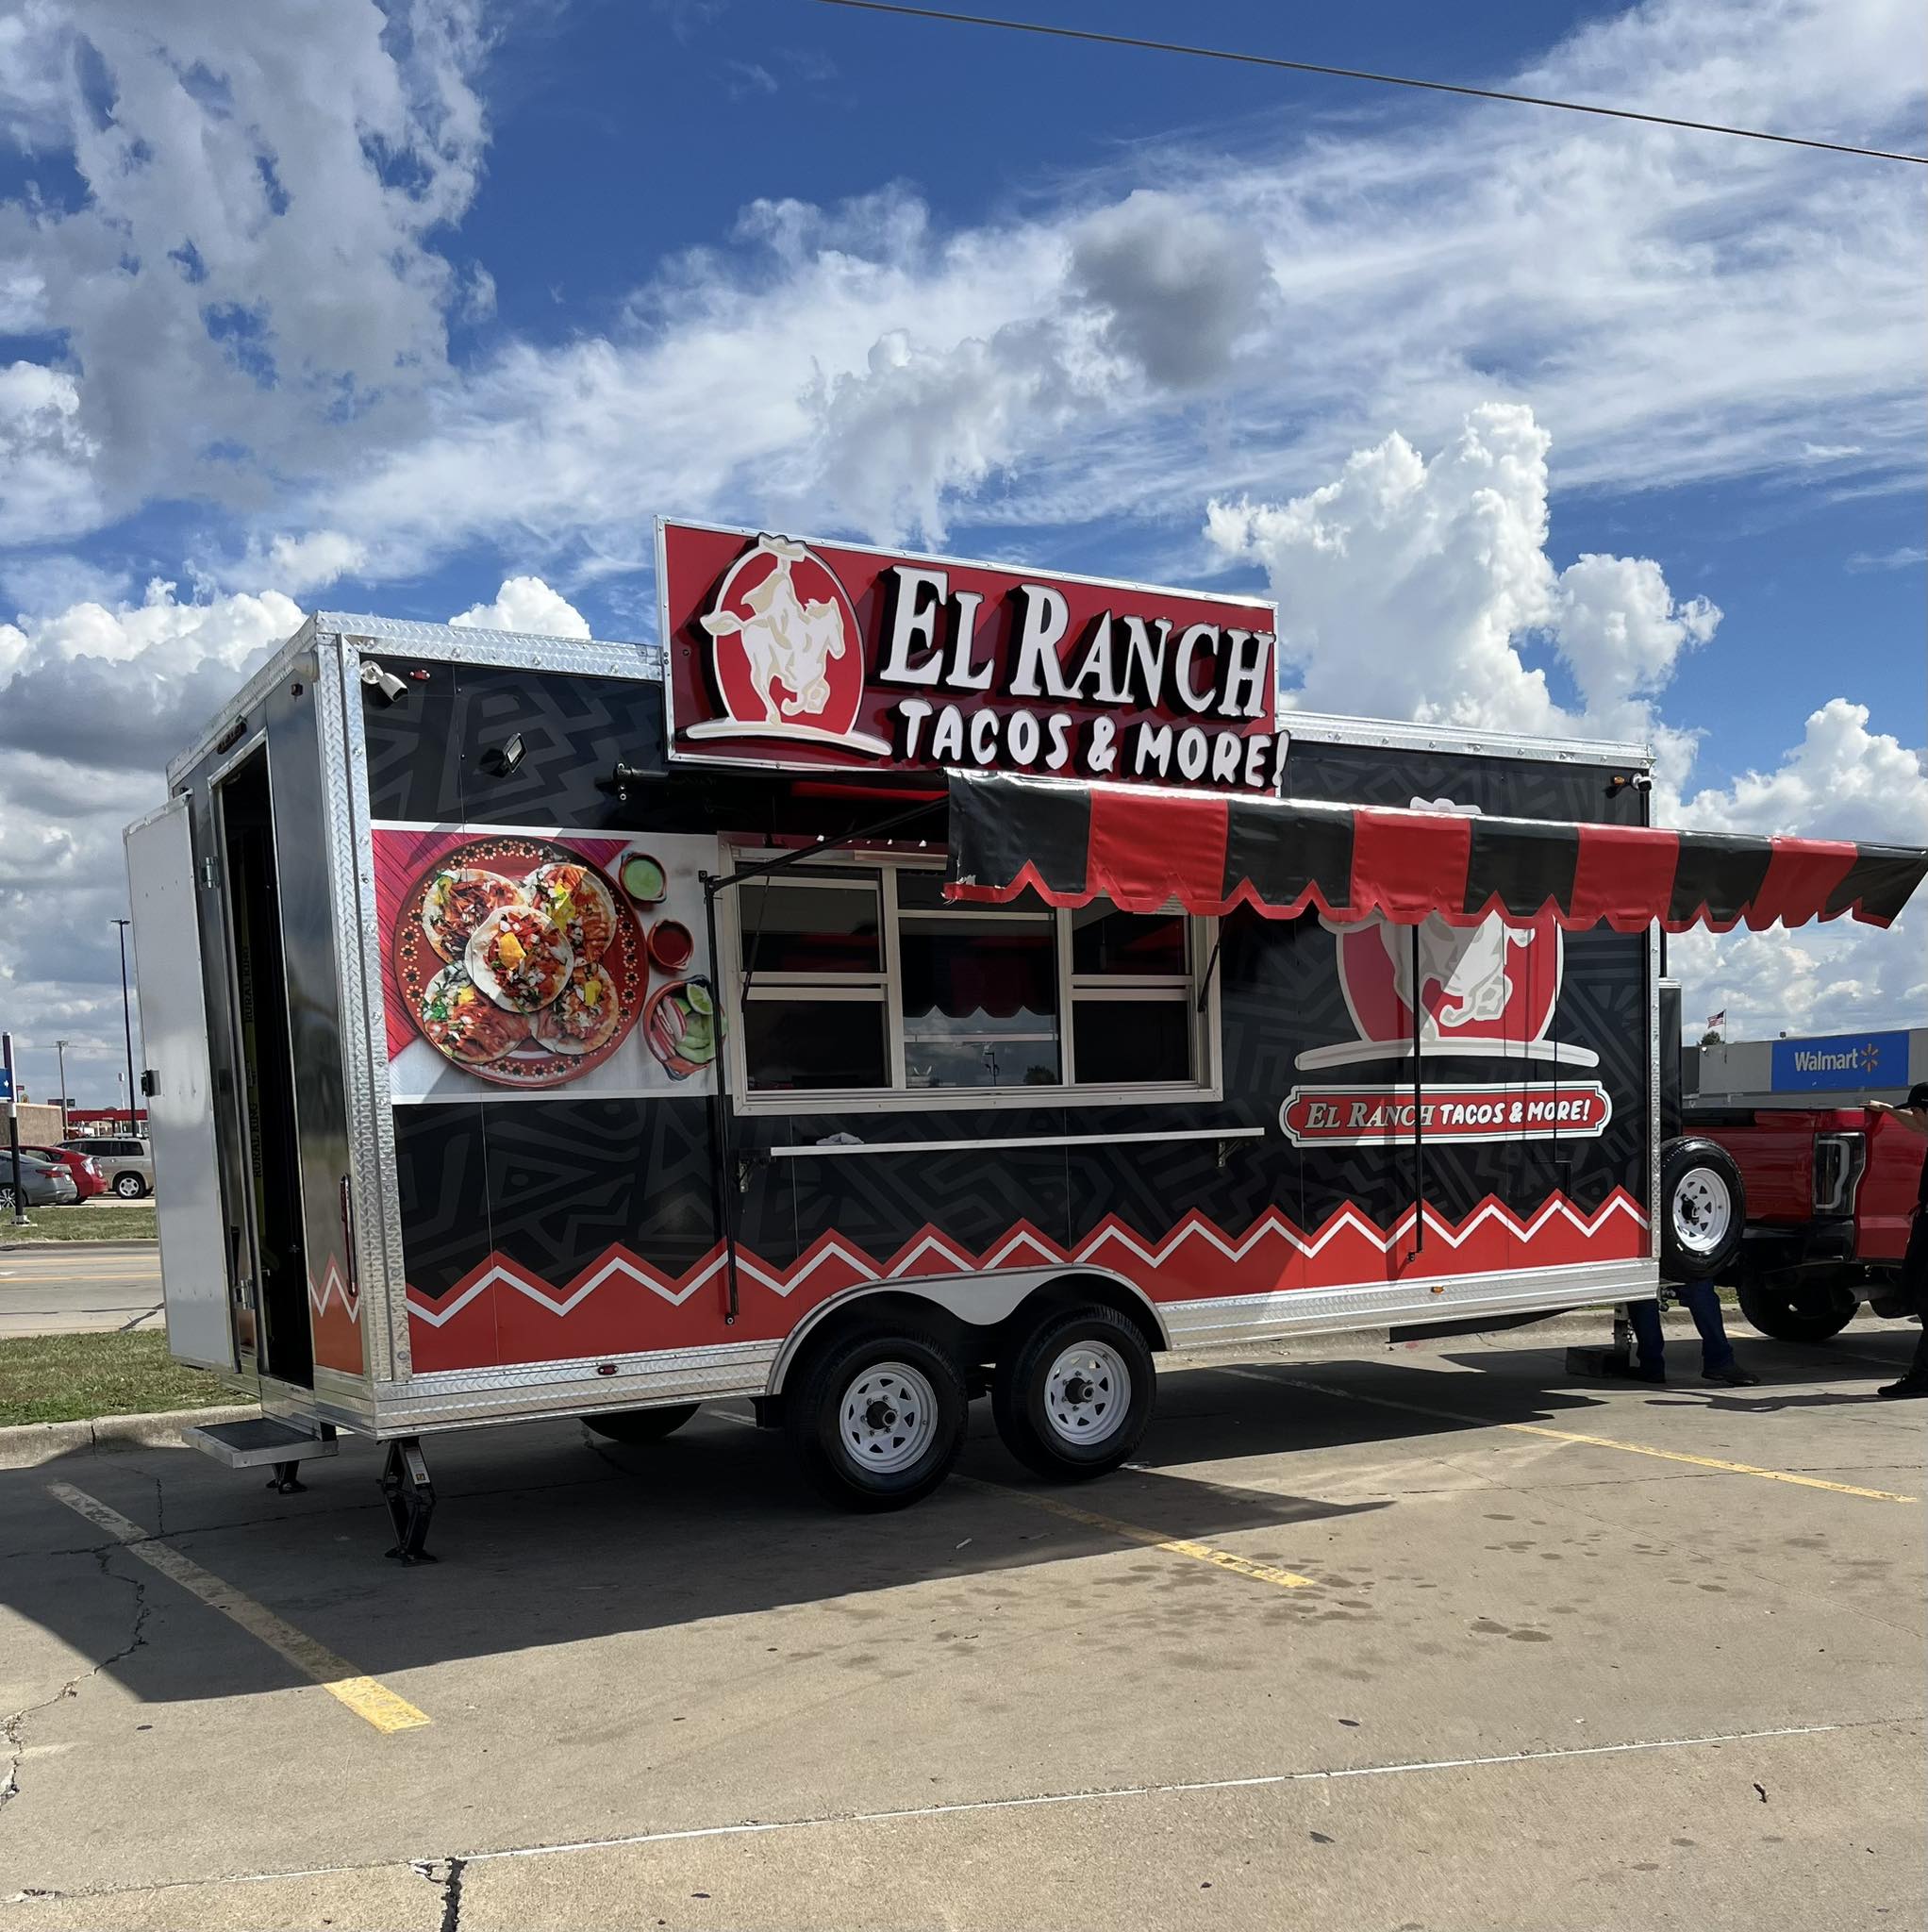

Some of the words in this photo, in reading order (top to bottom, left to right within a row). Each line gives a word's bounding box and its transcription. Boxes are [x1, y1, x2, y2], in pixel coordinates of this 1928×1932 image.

[880, 565, 993, 690] EL
[1009, 583, 1276, 718] RANCH
[899, 699, 1072, 771] TACOS
[1089, 715, 1117, 773] &
[1135, 724, 1290, 788] MORE!
[1795, 1048, 1858, 1072] Walmart
[248, 1102, 259, 1132] KING
[1305, 1102, 1340, 1129] EL
[1347, 1102, 1436, 1128] RANCH
[1439, 1102, 1505, 1125] TACOS
[1508, 1102, 1522, 1124] &
[1527, 1099, 1591, 1123] MORE!
[251, 1136, 261, 1177] RURAL
